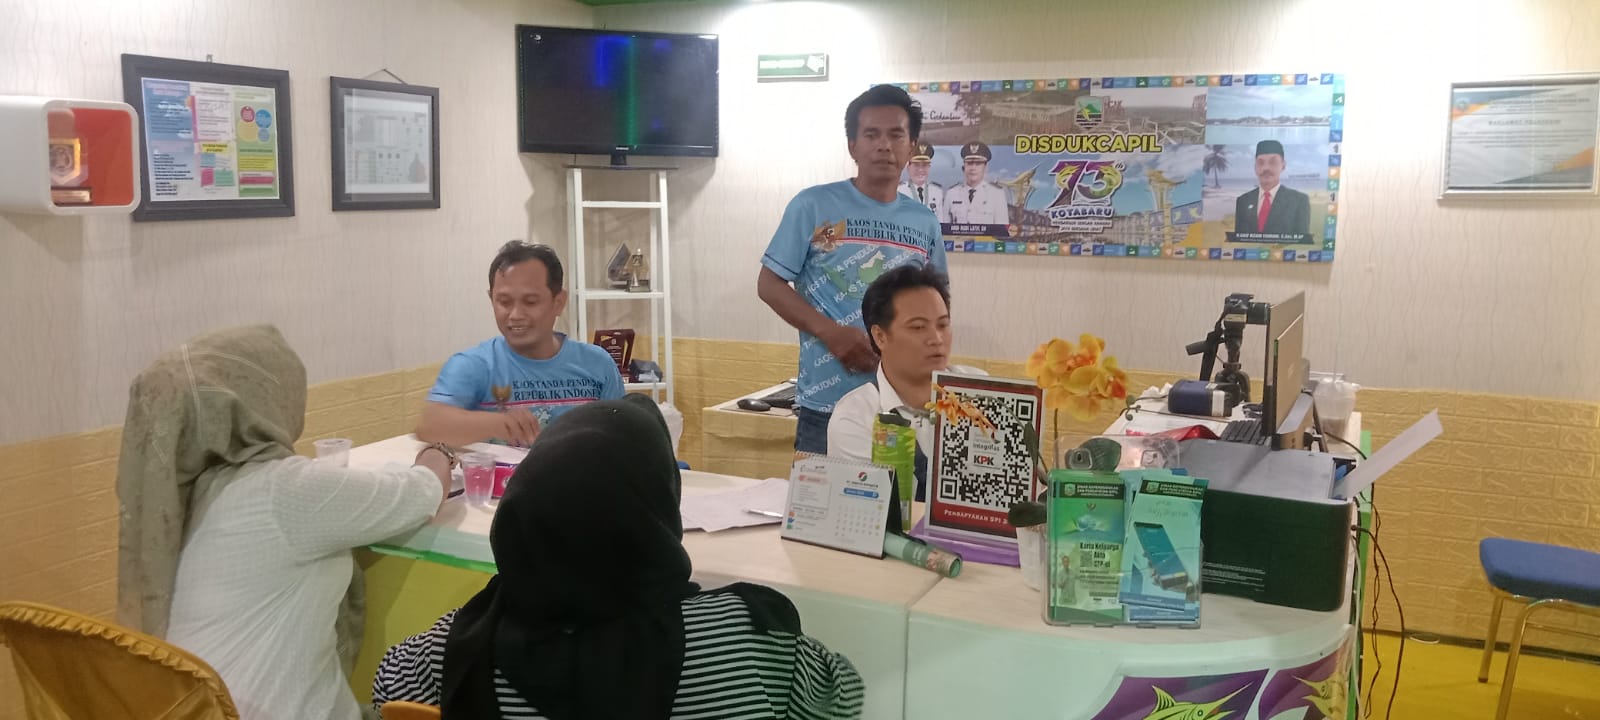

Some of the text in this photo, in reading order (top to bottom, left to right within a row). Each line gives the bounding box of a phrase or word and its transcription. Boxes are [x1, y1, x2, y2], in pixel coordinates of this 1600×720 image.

[1016, 134, 1162, 154] DISDUKCAPIL
[1050, 207, 1112, 219] KOTABARU
[846, 218, 871, 227] KAOS
[873, 220, 901, 233] TANDA
[847, 228, 897, 241] REPUBLIK
[513, 389, 563, 402] REPUBLIK
[973, 454, 995, 466] KPK
